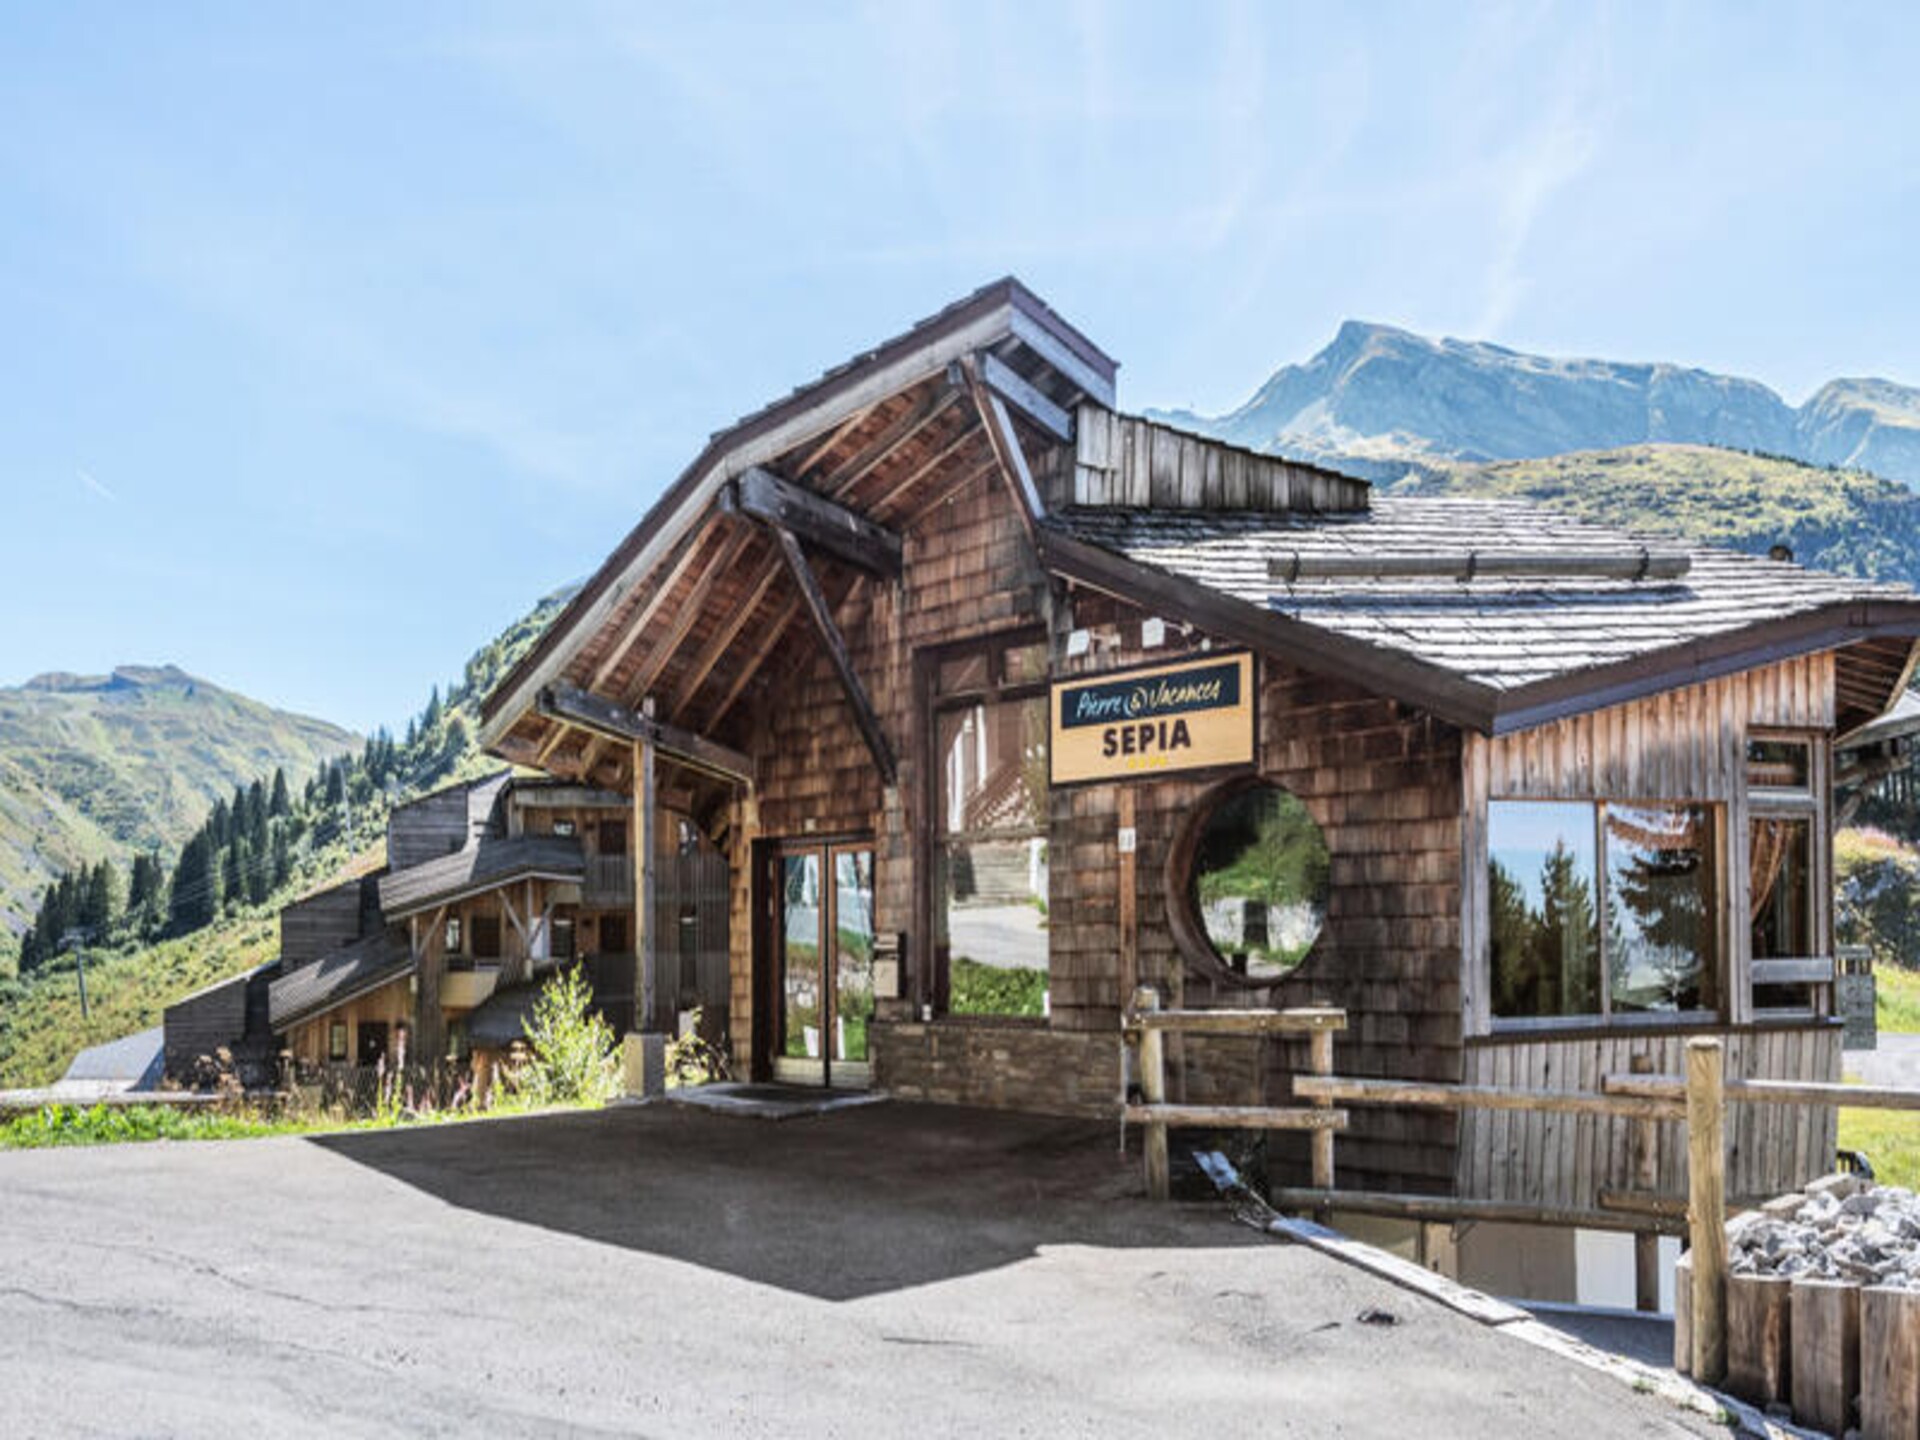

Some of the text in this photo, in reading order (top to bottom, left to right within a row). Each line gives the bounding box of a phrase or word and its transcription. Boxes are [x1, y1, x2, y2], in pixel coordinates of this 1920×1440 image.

[1076, 692, 1122, 718] Pierre
[1150, 679, 1221, 708] Vacances
[1103, 719, 1191, 757] SEPIA
